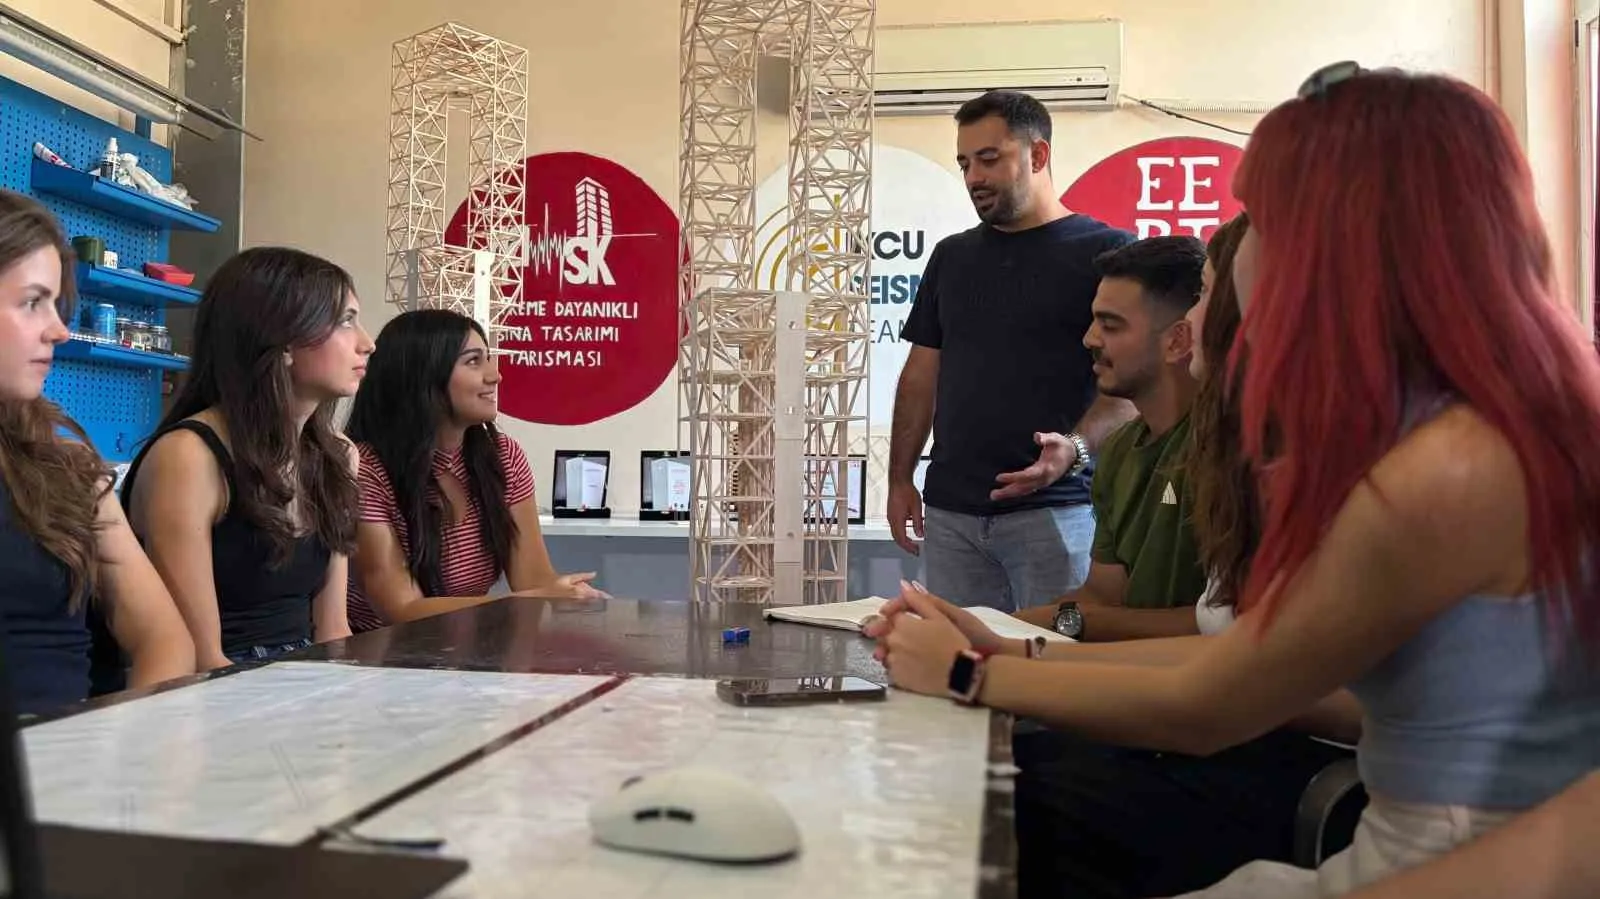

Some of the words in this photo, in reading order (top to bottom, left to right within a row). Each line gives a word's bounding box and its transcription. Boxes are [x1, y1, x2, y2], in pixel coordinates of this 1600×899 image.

[1136, 156, 1220, 211] EE
[852, 274, 920, 305] EIS
[555, 302, 638, 319] DAYANIKLI
[541, 325, 619, 342] TASARIMI
